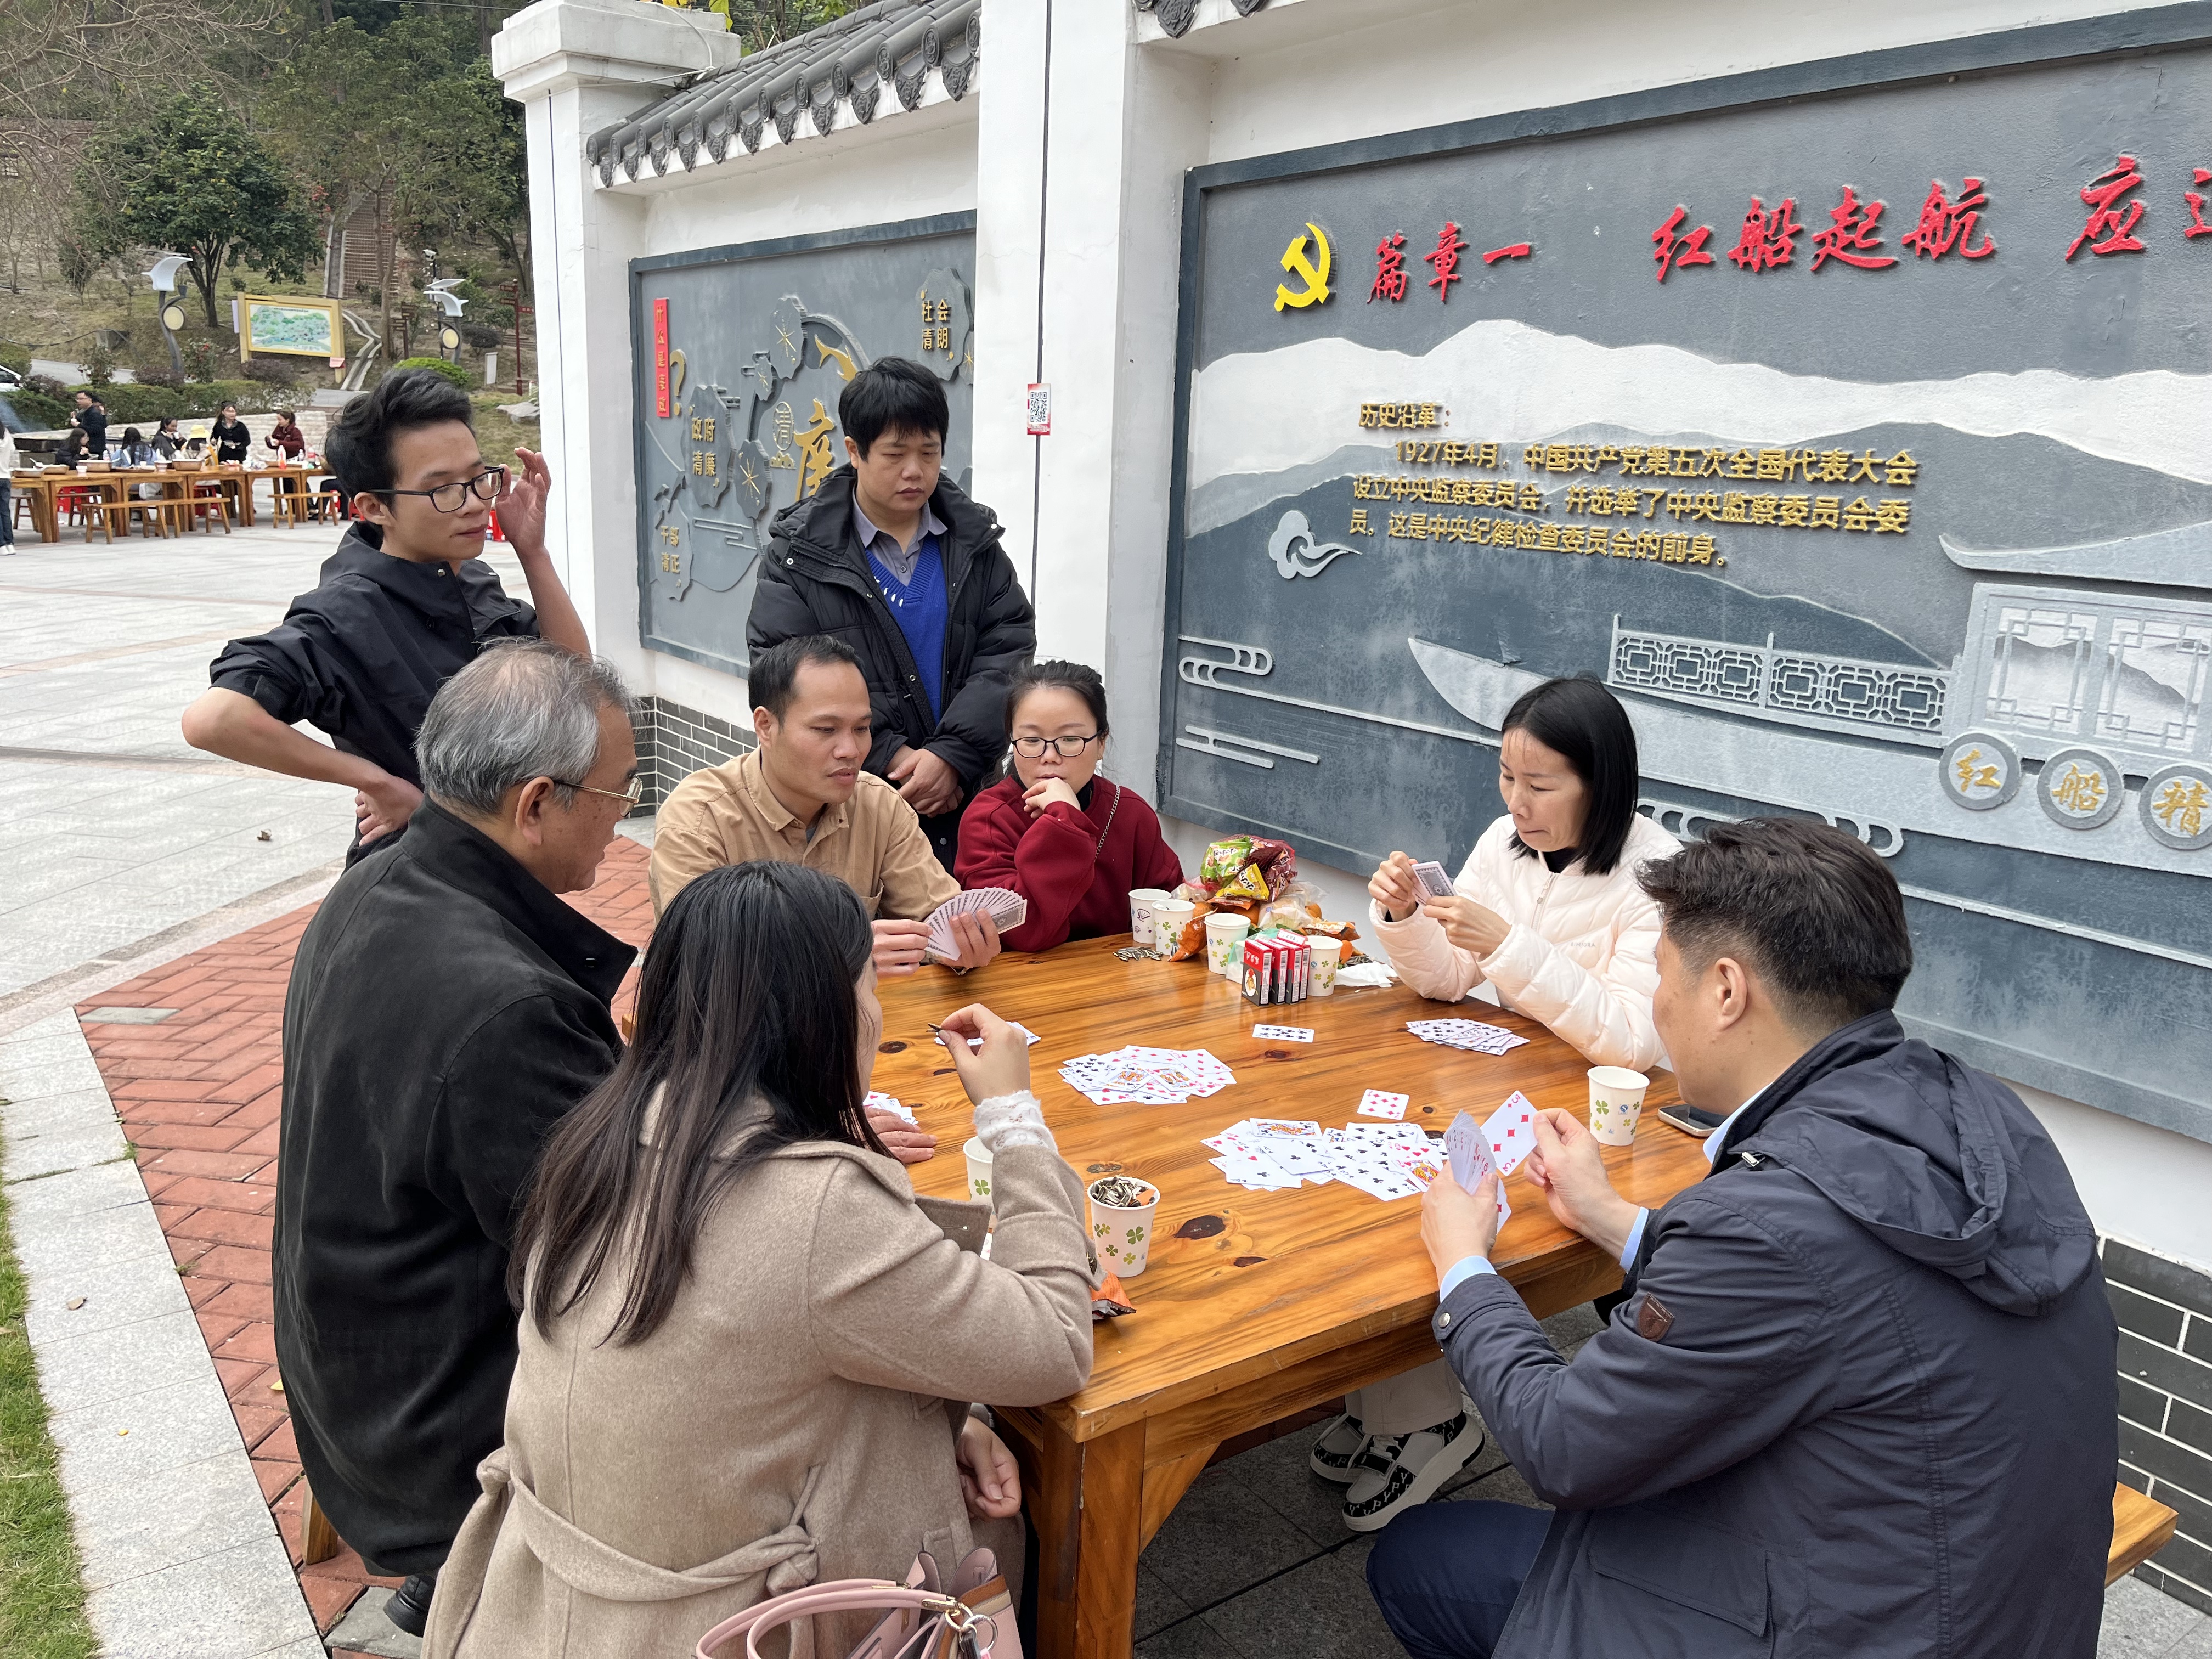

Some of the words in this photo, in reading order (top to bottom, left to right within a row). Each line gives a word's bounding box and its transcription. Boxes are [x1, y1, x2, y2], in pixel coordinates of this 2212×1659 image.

[1367, 221, 1531, 303] 篇章一
[1651, 177, 1996, 283] 红船起航
[922, 299, 948, 321] 社会
[922, 328, 948, 349] 清朗
[692, 417, 715, 442] 政府
[774, 408, 792, 445] 清
[693, 451, 716, 476] 清廉
[661, 526, 679, 546] 干部
[661, 552, 680, 574] 清正
[1511, 1094, 1521, 1104] 3
[1483, 1162, 1489, 1172] 6
[1502, 1163, 1512, 1172] 3
[1391, 1482, 1400, 1493] P
[1401, 1472, 1408, 1484] Y
[1372, 1500, 1382, 1511] P
[1384, 1491, 1391, 1503] Y
